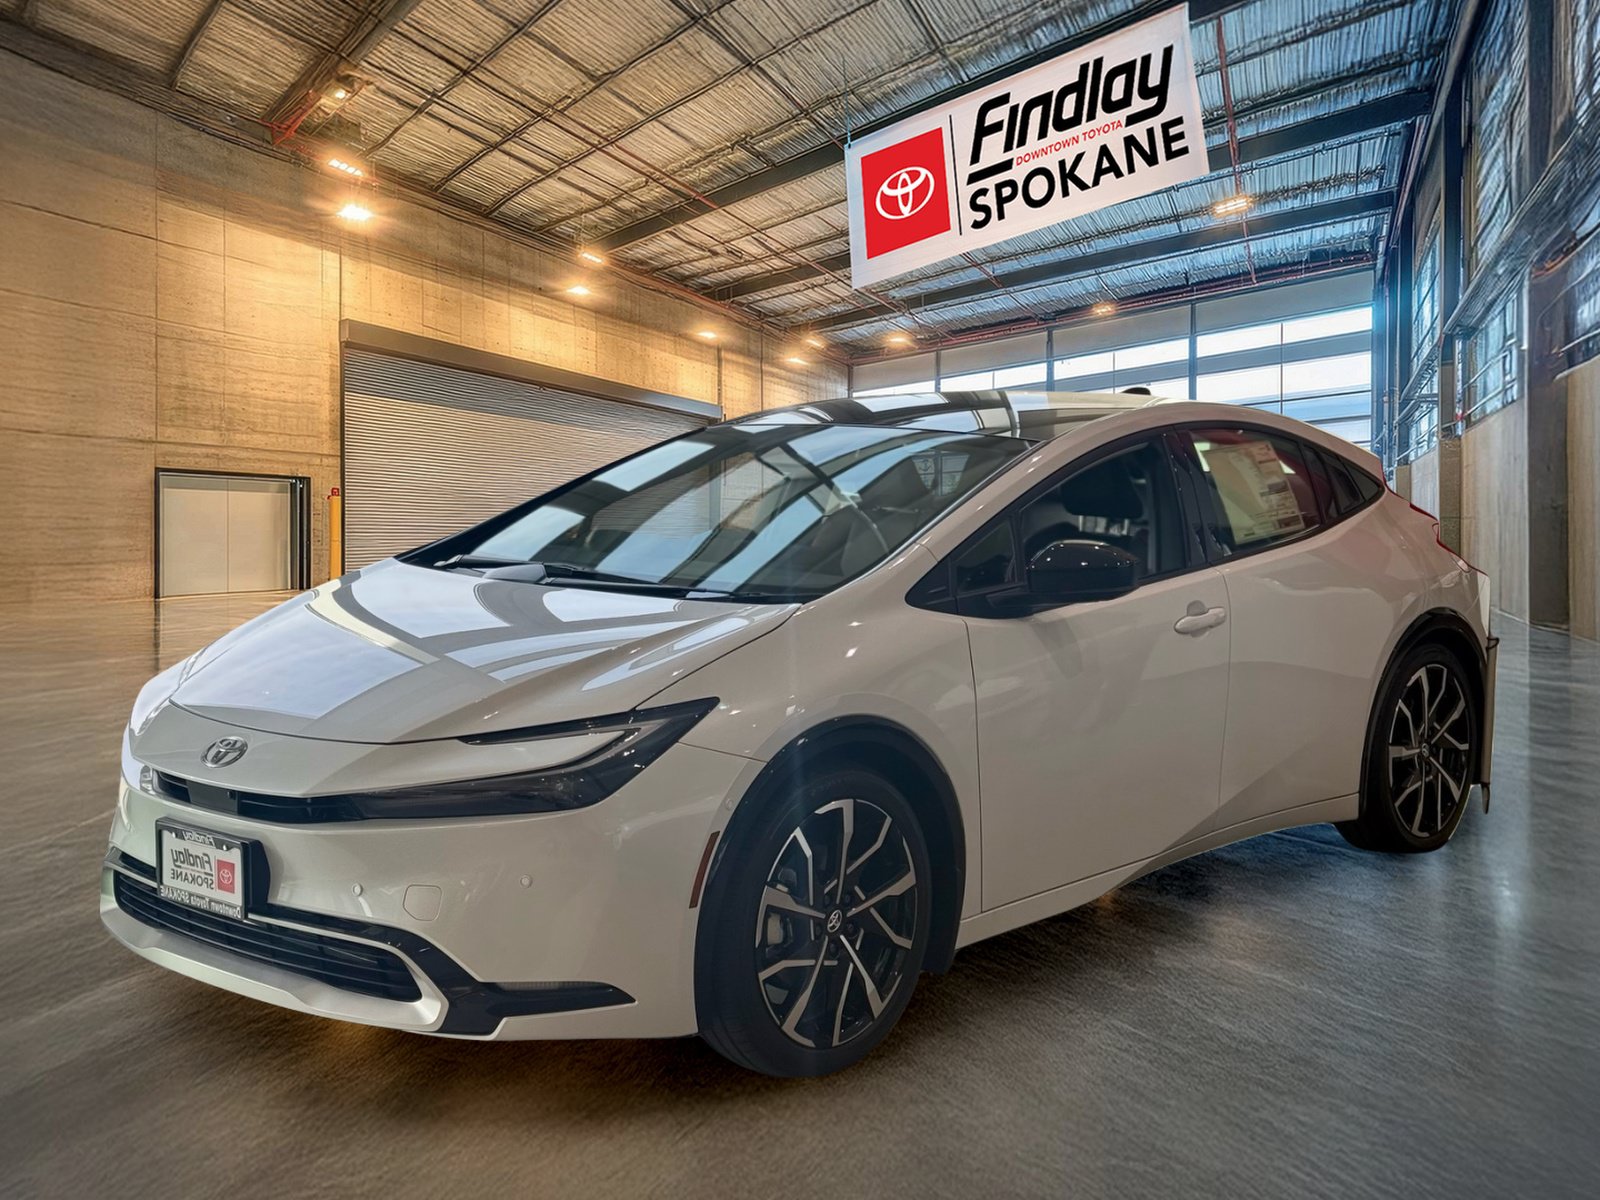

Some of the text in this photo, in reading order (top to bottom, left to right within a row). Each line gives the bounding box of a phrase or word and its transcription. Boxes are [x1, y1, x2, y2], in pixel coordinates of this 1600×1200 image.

[967, 44, 1174, 172] Findlay
[1015, 119, 1123, 166] DOWNTOWN TOYOTA
[970, 116, 1189, 230] SPOKANE
